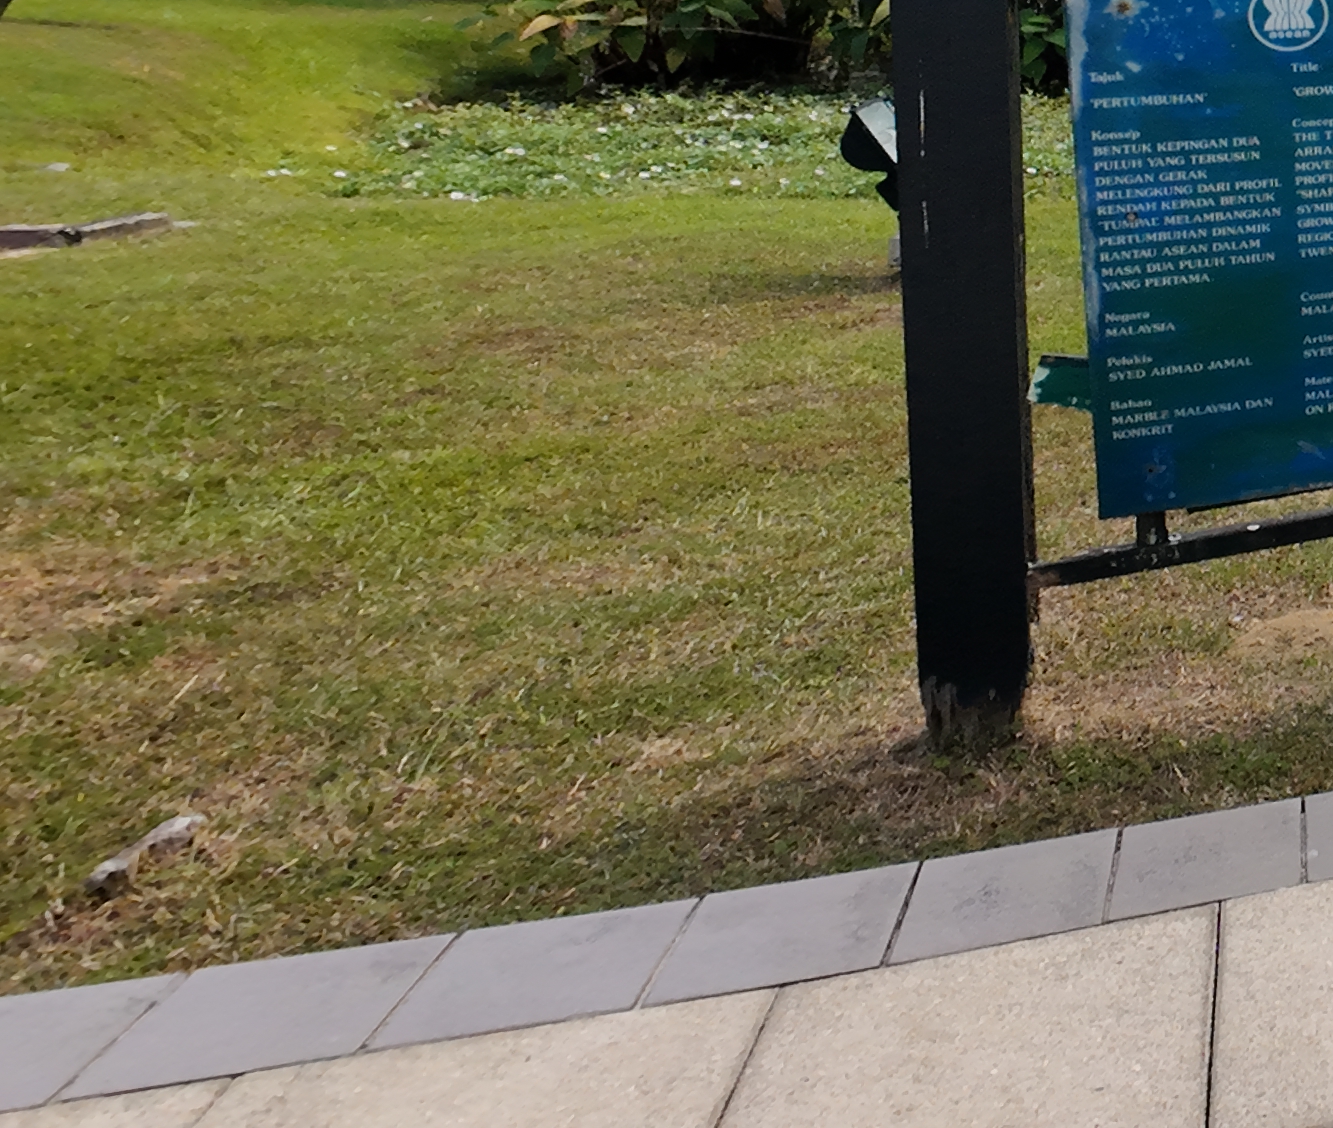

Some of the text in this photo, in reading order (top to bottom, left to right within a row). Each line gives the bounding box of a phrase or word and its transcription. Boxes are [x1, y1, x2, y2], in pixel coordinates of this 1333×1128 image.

[1291, 62, 1319, 73] Title
[1089, 71, 1124, 84] Tajuk
[1091, 129, 1141, 141] Konsep
[1293, 131, 1320, 143] THE
[1093, 136, 1260, 157] BENTUK KEPINGAN DUA
[1094, 151, 1260, 171] PULUH YANG TERSUSUN
[1094, 169, 1208, 187] DENGAN GERAK
[1096, 178, 1282, 201] MELENGKUNG DARI PROFIL
[1097, 192, 1275, 216] RENDAH KEPADA BENTUK
[1164, 207, 1281, 226] MELAMBANGKAN
[1099, 223, 1271, 246] PERTUMBUHAN DINAMIK
[1100, 239, 1261, 262] RANTAU ASEAN DALAM
[1101, 252, 1275, 277] MASA DUA PULUH TAHUN
[1102, 278, 1141, 291] YANG
[1105, 322, 1176, 338] MALAYSIA
[1108, 357, 1253, 382] SYED AHMAD JAMAL
[1111, 397, 1274, 426] MARBLE MALAYSIA DAN
[1305, 404, 1324, 415] ON
[1112, 424, 1174, 440] KONKRIT
